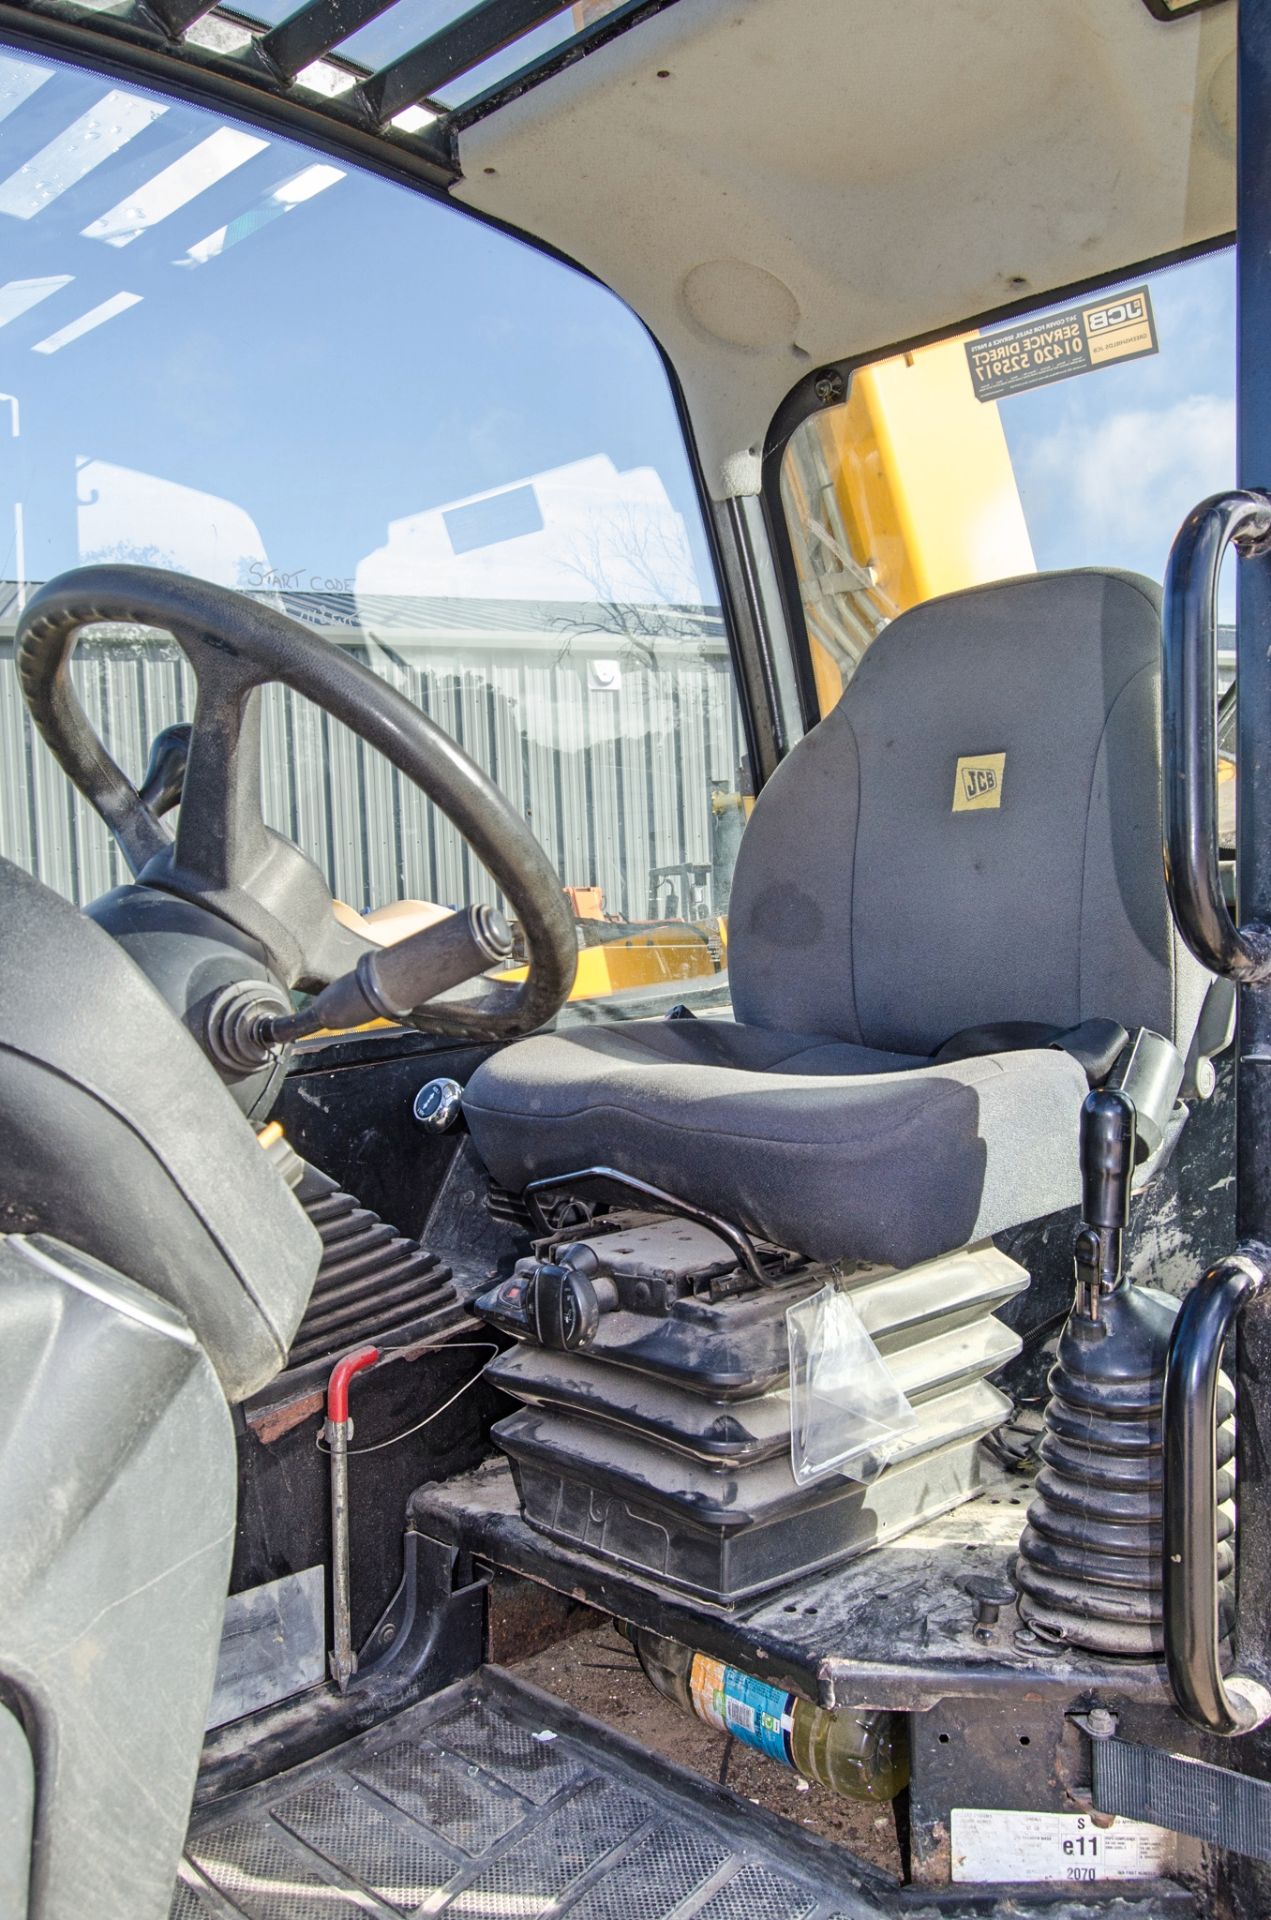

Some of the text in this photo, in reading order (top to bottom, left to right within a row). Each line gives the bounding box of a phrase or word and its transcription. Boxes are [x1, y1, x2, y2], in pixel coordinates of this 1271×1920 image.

[247, 562, 356, 592] START CODE
[967, 770, 995, 796] JCB
[1063, 1836, 1097, 1856] e11
[1067, 1867, 1096, 1881] 2070
